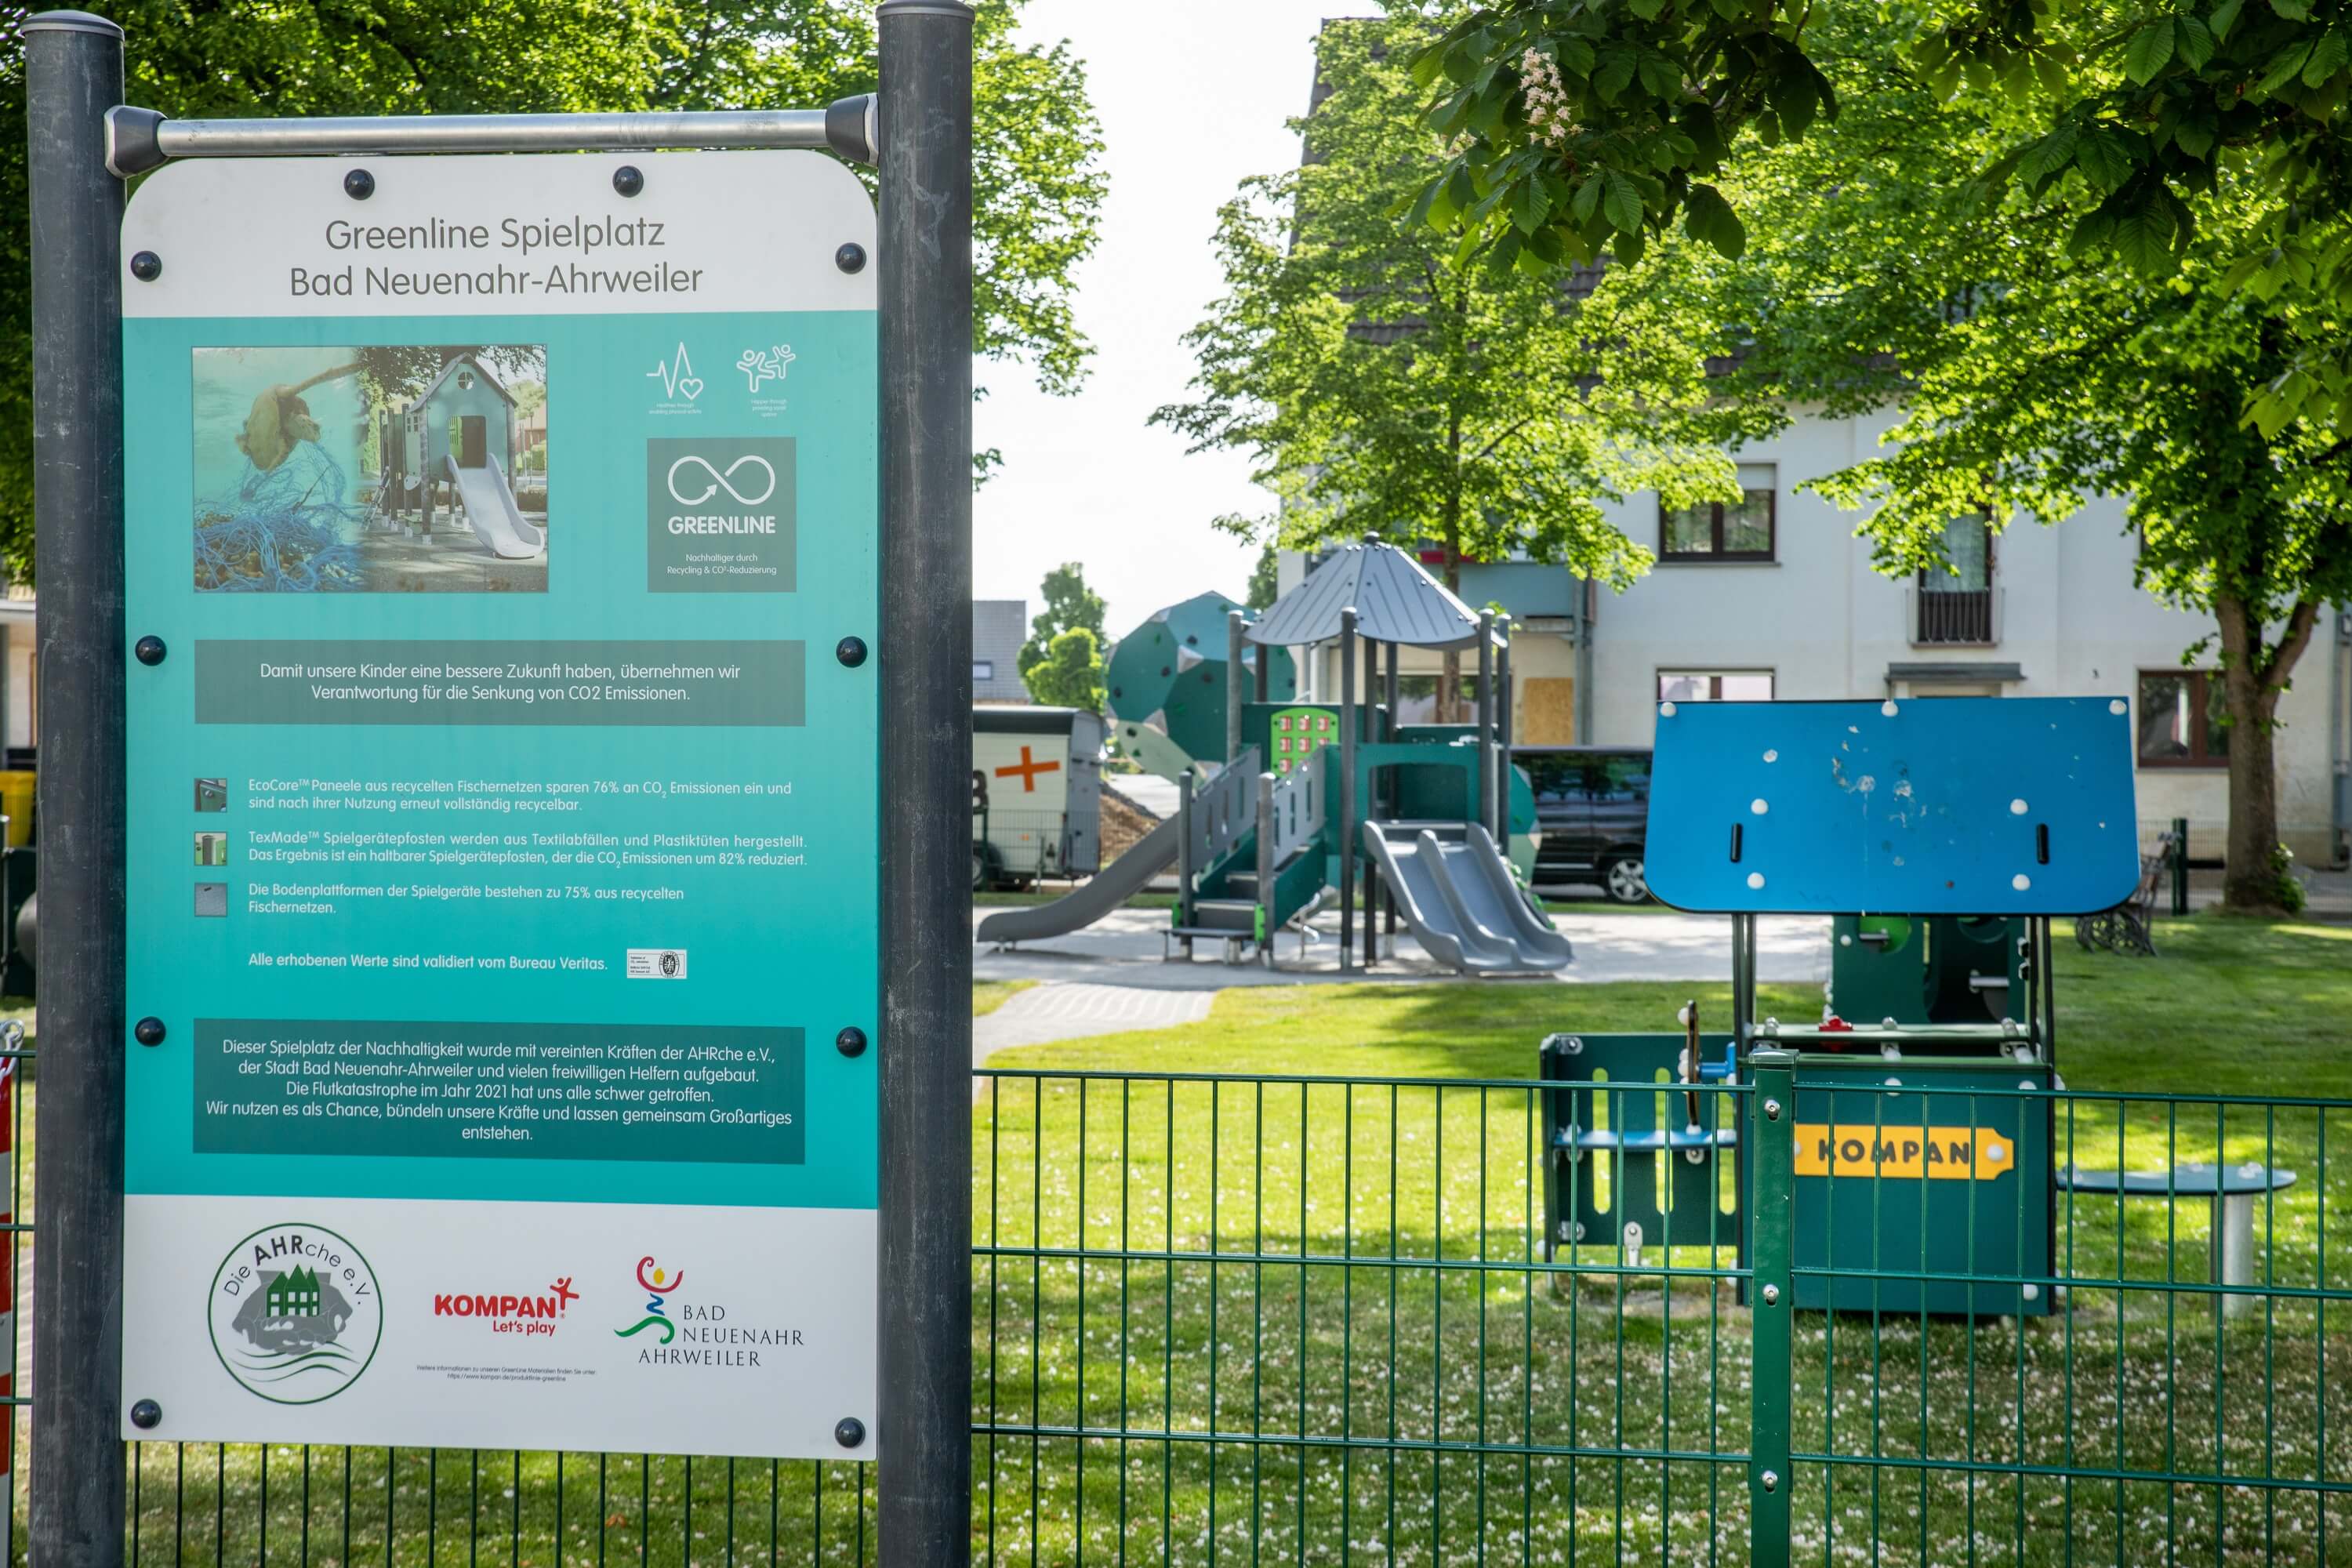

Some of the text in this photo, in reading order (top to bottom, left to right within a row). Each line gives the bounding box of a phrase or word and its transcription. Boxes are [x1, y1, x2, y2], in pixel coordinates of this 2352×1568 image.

[325, 215, 666, 256] Greenline Spielplatz
[291, 261, 703, 296] Bad Neuenahr-Ahrweiler
[668, 515, 776, 535] GREENLINE
[685, 553, 758, 564] Nachhaltiger durch
[666, 565, 702, 576] Recycling
[703, 565, 710, 575] &
[260, 662, 741, 681] Damit unsere Kinder eine bessere Zukunft haben, übernehmen wir
[311, 684, 691, 703] Verantwortung für die Senkung von CO2 Emissionen.
[311, 779, 361, 792] Paneele
[365, 782, 388, 792] aus
[391, 779, 454, 795] recycelten
[457, 779, 543, 793] Fischernetzen
[546, 783, 590, 796] sparen
[593, 781, 619, 793] 76%
[622, 783, 640, 793] an
[670, 781, 741, 794] Emissionen
[743, 782, 764, 794] ein
[767, 781, 792, 795] und
[249, 796, 583, 814] sind nach ihrer Nutzung erneut vollständig recycelbar.
[323, 831, 445, 848] Spielgerätepfosten
[449, 832, 499, 845] werden
[503, 835, 528, 846] aus
[532, 833, 619, 846] Textilabfällen
[623, 833, 649, 847] und
[653, 833, 730, 848] Plastiktüten
[734, 834, 808, 851] hergestellt.
[249, 848, 274, 861] Das
[275, 848, 329, 864] Ergebnis
[331, 849, 346, 862] ist
[347, 849, 367, 862] ein
[369, 848, 426, 862] haltbarer
[429, 849, 548, 866] Spielgerätepfosten,
[551, 850, 573, 863] der
[575, 850, 595, 864] die
[622, 851, 693, 865] Emissionen
[695, 855, 717, 866] um
[717, 851, 746, 866] 82%
[747, 852, 808, 866] reduziert.
[249, 883, 684, 902] Die Bodenplattformen der Spielgeräte bestehen zu 75% aus recycelten
[249, 899, 336, 913] Fischernetzen.
[248, 953, 608, 971] Alle erhobenen Werte sind validiert vom Bureau Veritas.
[223, 1039, 775, 1064] Dieser Spielplatz der Nachhaltigkeit wurde mit vereinten Kräften der AHRche e.V.,
[238, 1059, 759, 1085] der Stadt Bad Neuenahr-Ahrweiler und vielen freiwilligen Helfern aufgebaut.
[286, 1080, 715, 1105] Die Flutkatastrophe im Jahr 2021 hat uns alle schwer getroffen.
[206, 1100, 792, 1128] Wir nutzen es als Chance, bündeln unsere Kräfte und lassen gemeinsam Großartiges
[462, 1124, 533, 1141] entstehen.
[1817, 1138, 1970, 1165] KOMPAN
[223, 1235, 371, 1305] Die AHRche e.V.
[434, 1294, 557, 1319] KOMPAN
[684, 1305, 725, 1321] BAD
[526, 1319, 556, 1337] play
[683, 1327, 804, 1345] NEUENAHR
[638, 1348, 760, 1367] AHRWEILER
